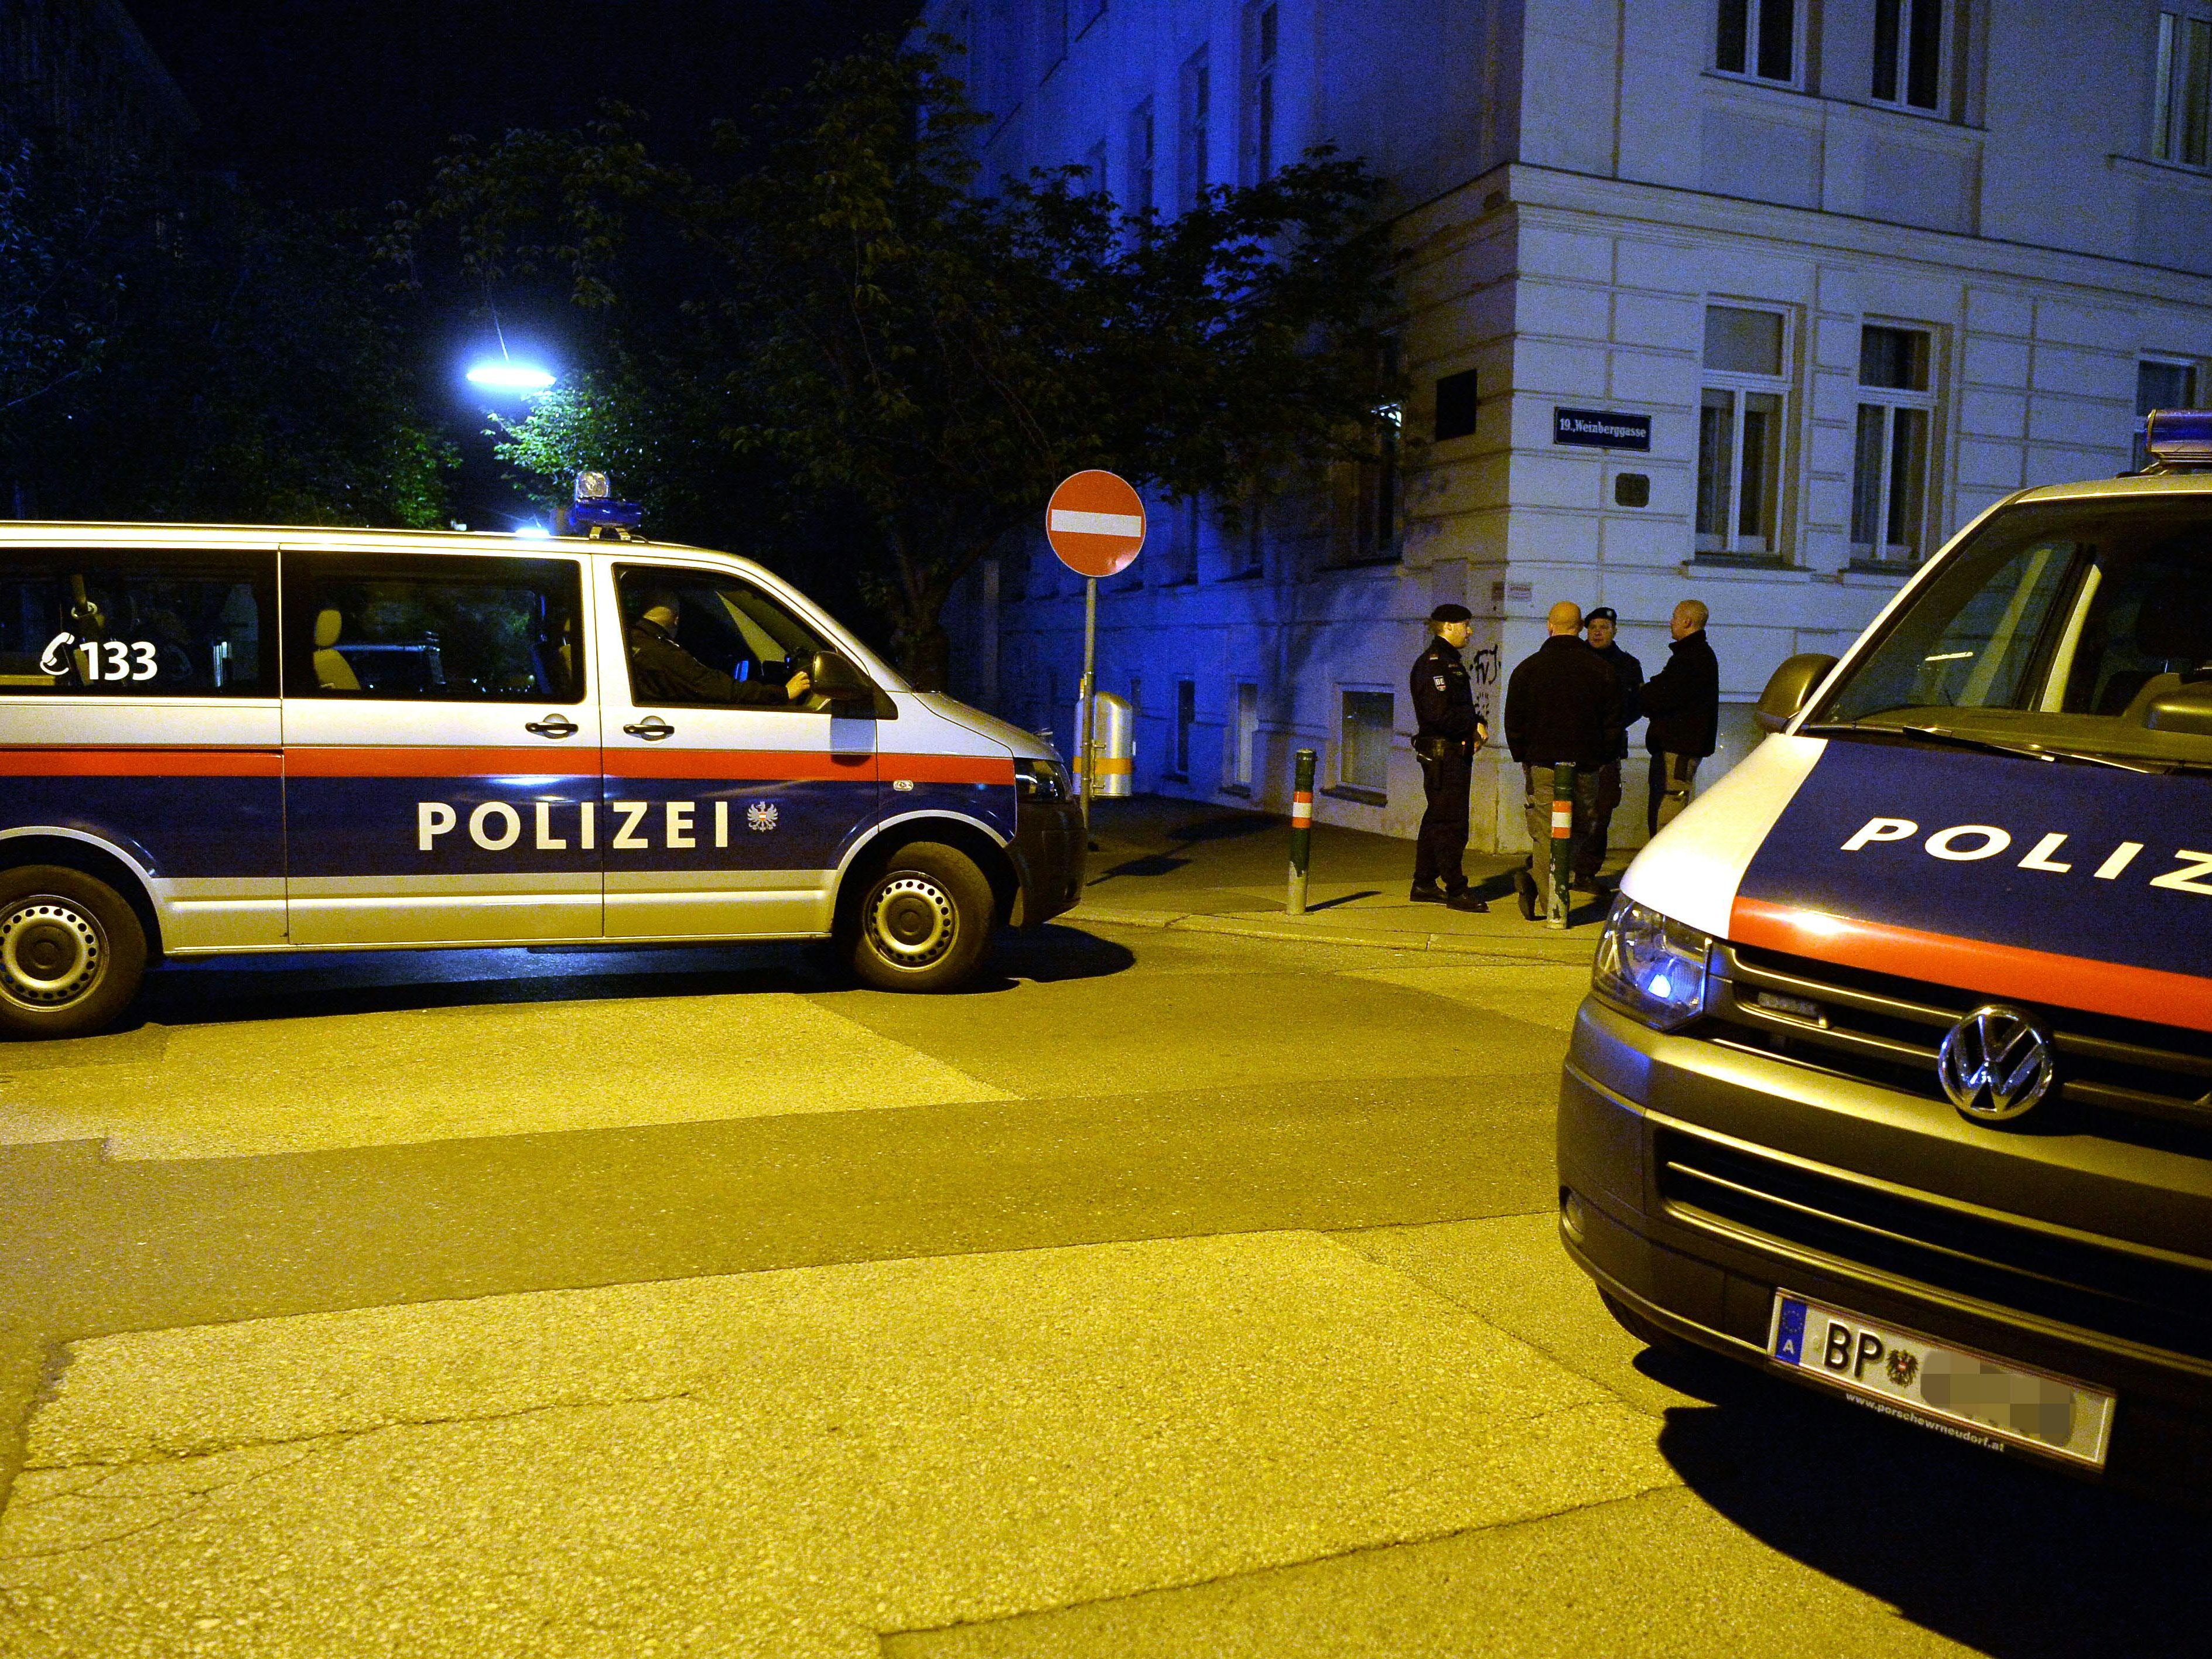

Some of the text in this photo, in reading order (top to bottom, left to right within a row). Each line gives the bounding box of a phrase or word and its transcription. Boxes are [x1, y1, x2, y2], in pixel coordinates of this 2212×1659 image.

[1575, 419, 1646, 437] Weinberggasse
[80, 641, 158, 680] 133
[418, 801, 728, 850] POLIZEI
[1840, 817, 2212, 895] POLIZ
[1783, 1319, 1883, 1379] A BP
